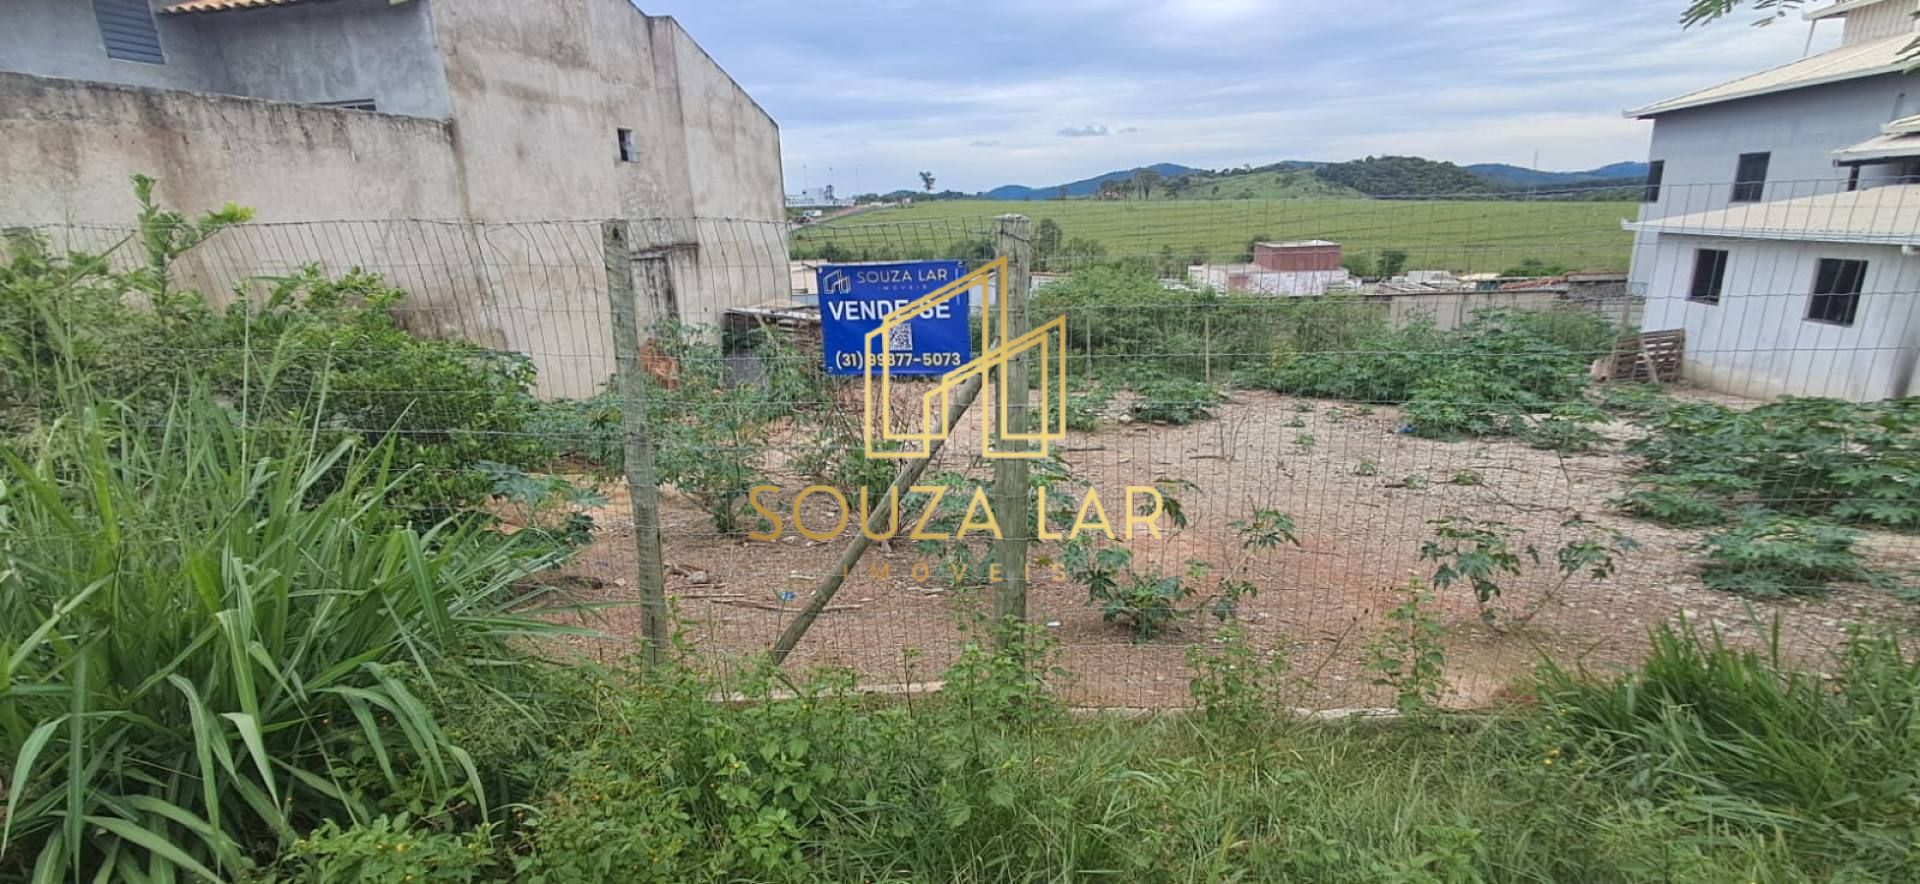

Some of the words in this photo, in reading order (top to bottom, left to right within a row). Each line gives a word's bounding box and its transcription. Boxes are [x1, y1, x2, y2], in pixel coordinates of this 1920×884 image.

[857, 270, 912, 283] SOUZA
[919, 269, 947, 281] LAR
[828, 300, 950, 320] VENDESE
[836, 351, 863, 369] (31)
